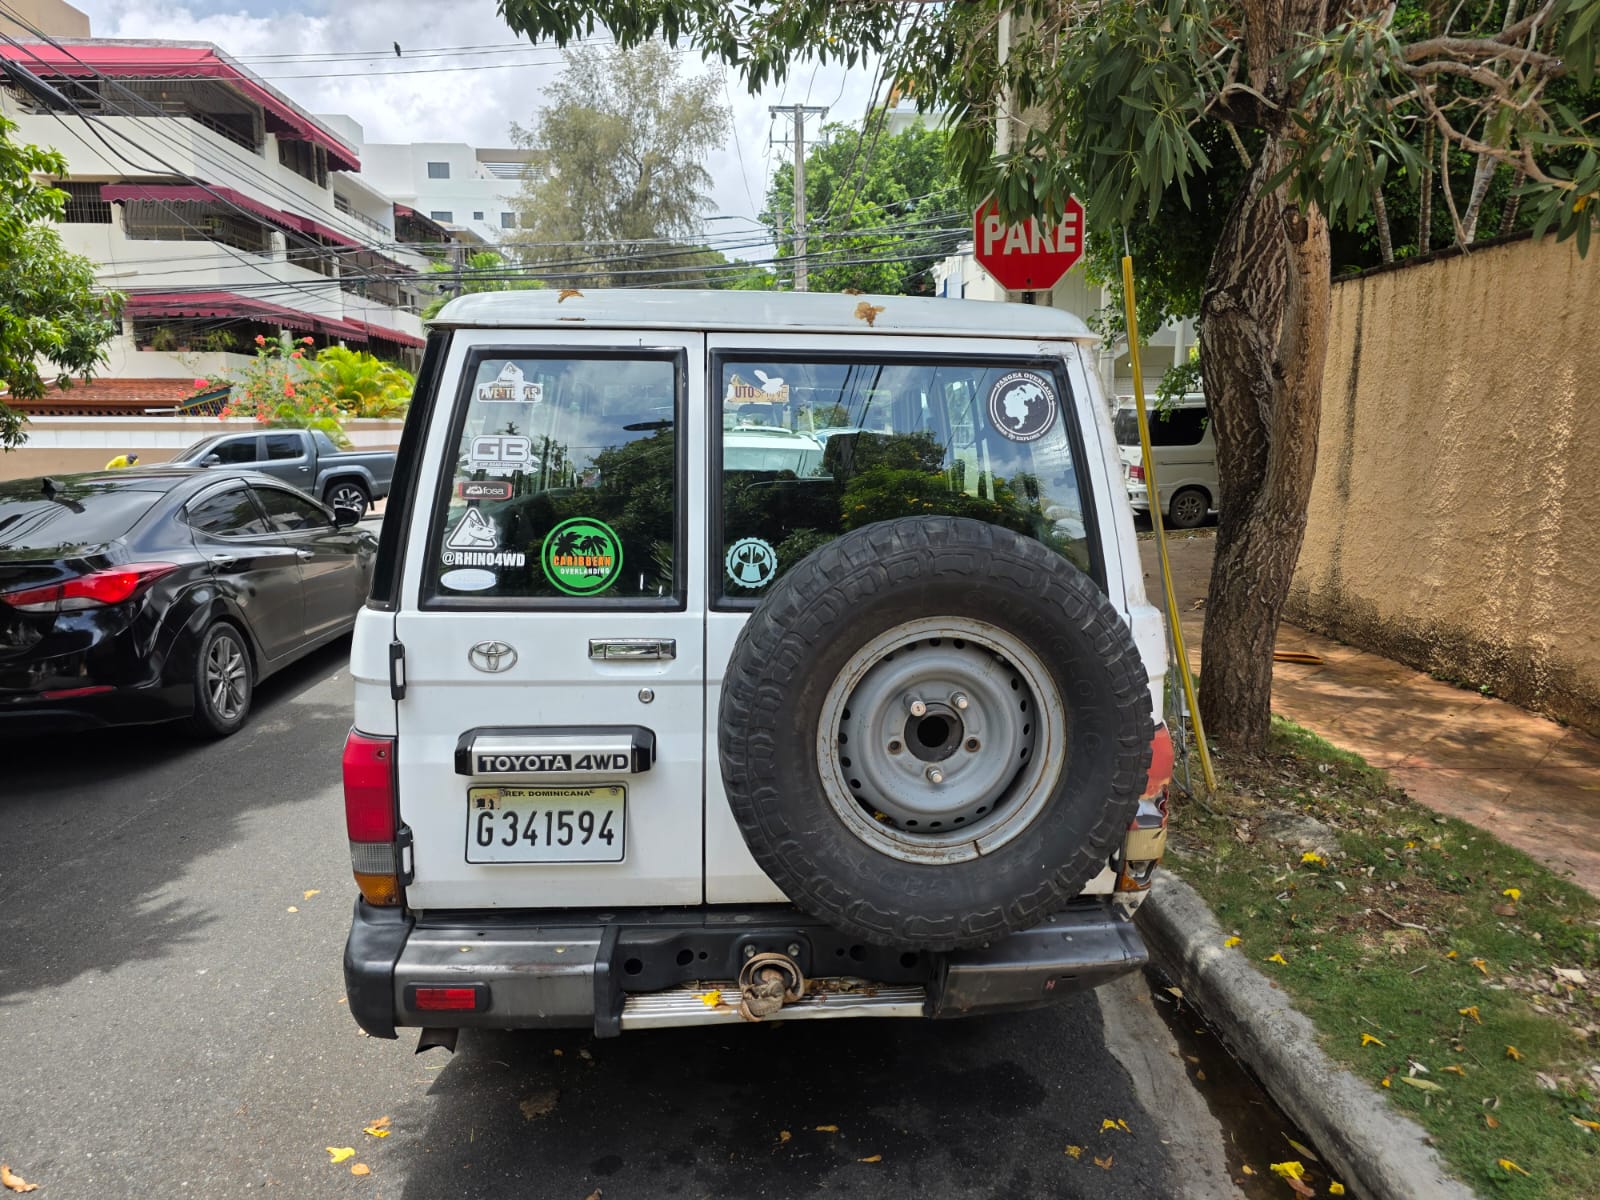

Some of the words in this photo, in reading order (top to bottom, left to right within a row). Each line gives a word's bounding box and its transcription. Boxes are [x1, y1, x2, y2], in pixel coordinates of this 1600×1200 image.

[984, 212, 1077, 256] PARE
[996, 372, 1022, 388] PANGEA
[1024, 372, 1054, 401] OVERLAND
[442, 552, 525, 567] @RHINO4WD
[553, 555, 611, 567] CARIBBEAN
[560, 567, 610, 575] OVERLANDING
[482, 756, 567, 771] TOYOTA
[574, 754, 629, 771] 4WD
[476, 810, 615, 847] G341594
